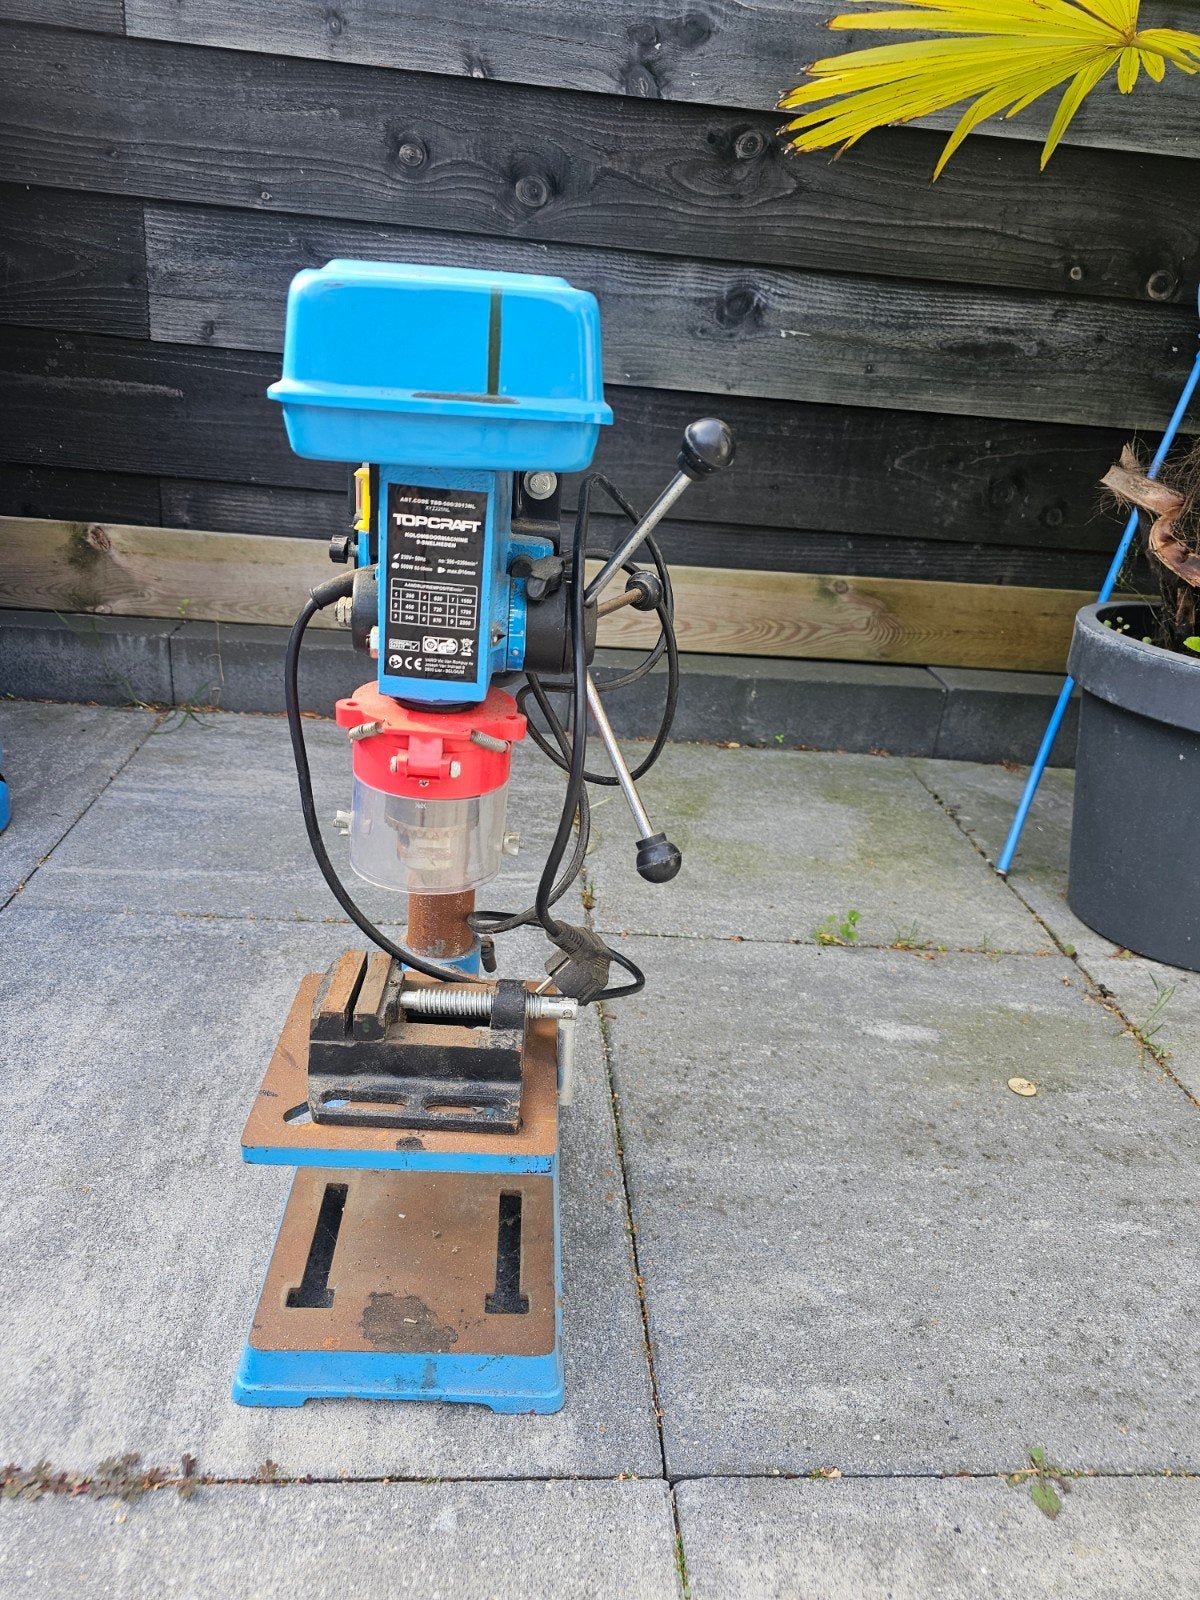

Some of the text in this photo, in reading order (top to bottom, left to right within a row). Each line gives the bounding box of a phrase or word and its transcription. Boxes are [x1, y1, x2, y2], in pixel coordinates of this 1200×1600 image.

[393, 512, 482, 532] TOPCRAFT
[405, 532, 468, 543] KOLOMBOORMACHINE
[404, 656, 422, 671] CE
